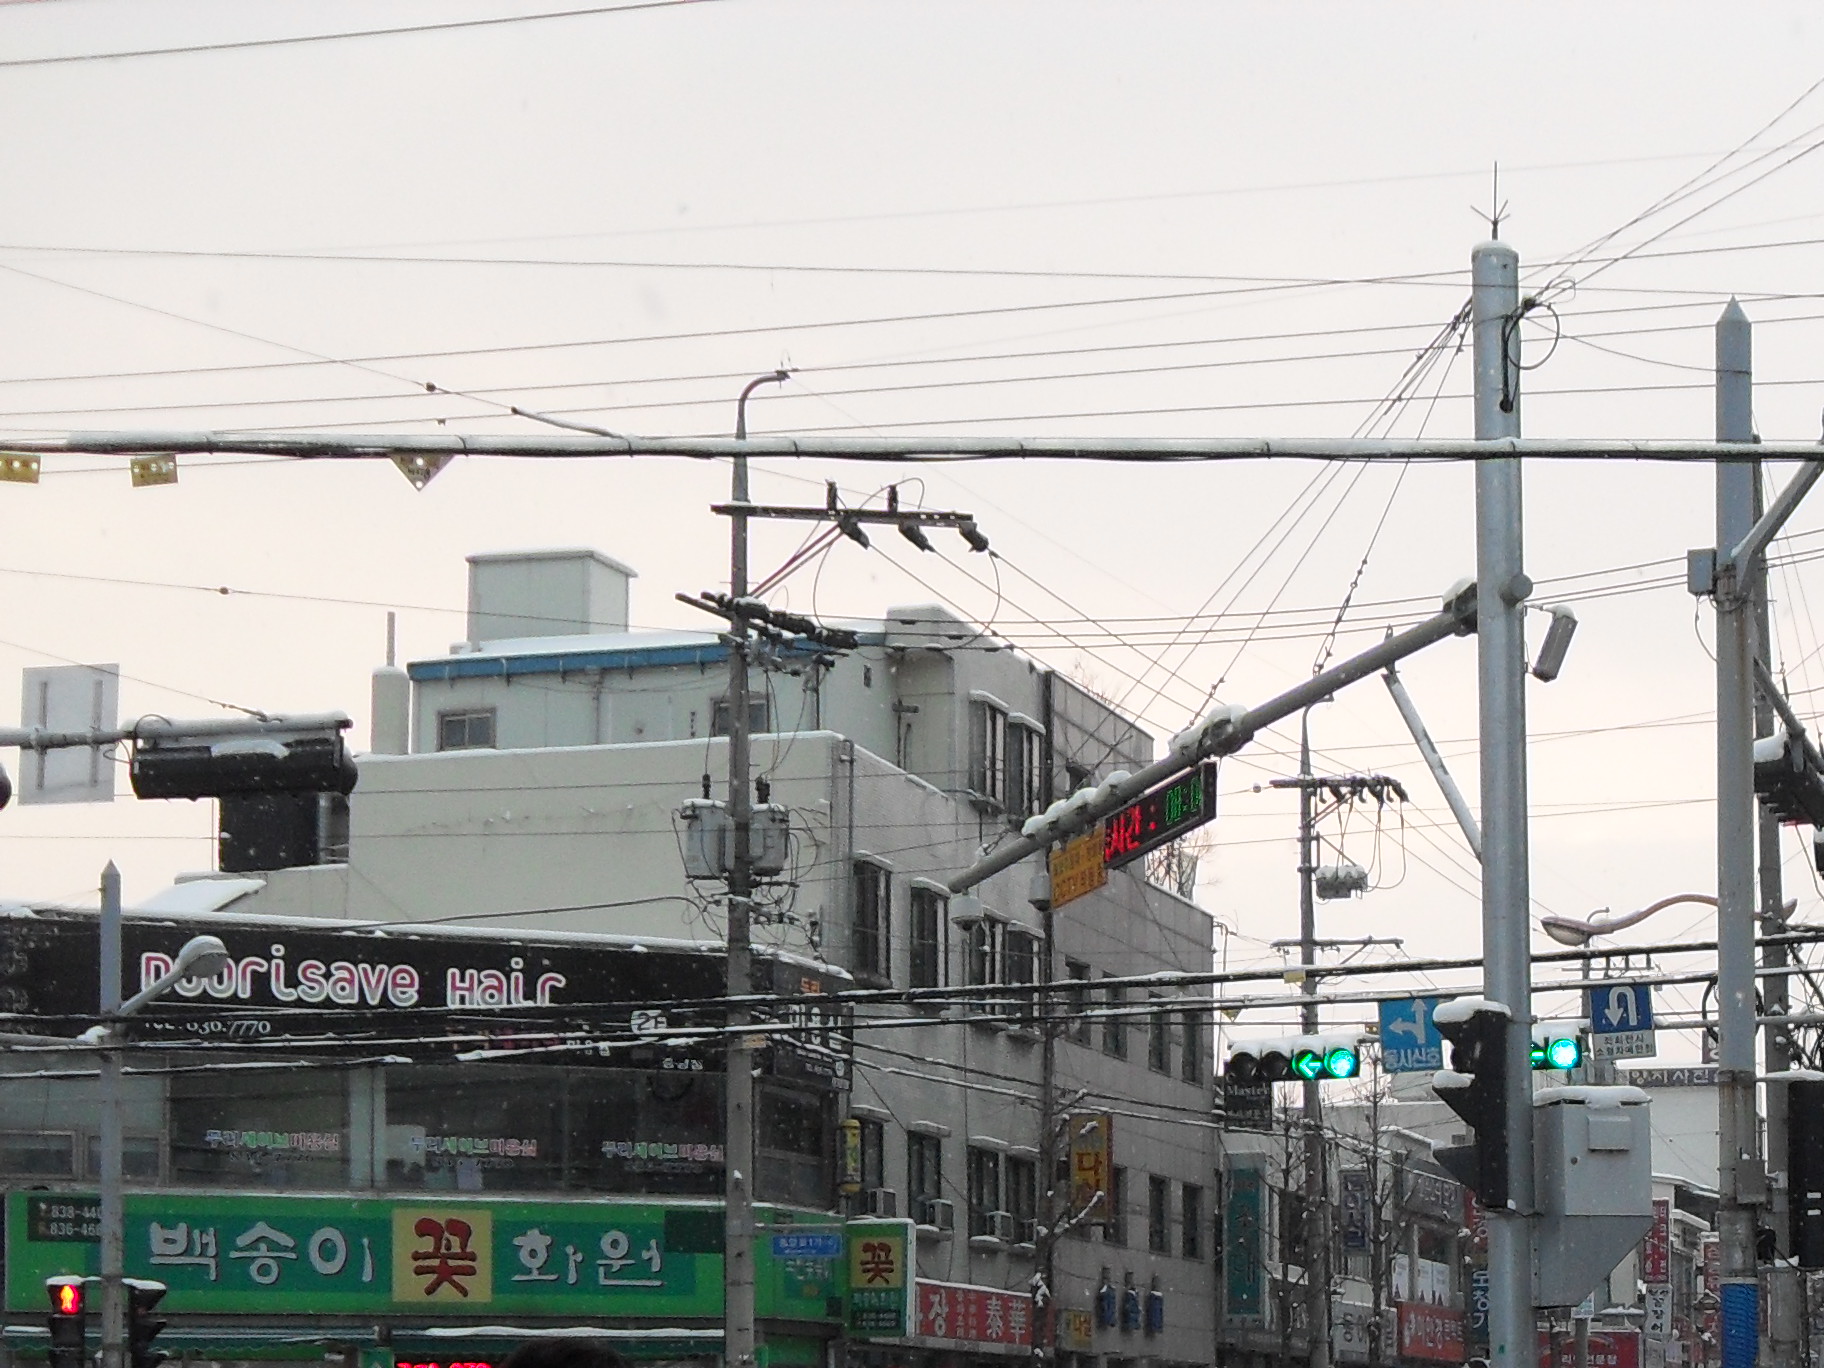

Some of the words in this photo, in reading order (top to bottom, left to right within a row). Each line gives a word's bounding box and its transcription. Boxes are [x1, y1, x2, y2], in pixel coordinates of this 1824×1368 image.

[446, 957, 567, 1008] Hair
[149, 1221, 374, 1285] 백송이
[410, 1217, 477, 1298] 꽃
[511, 1227, 665, 1287] 화원
[860, 1242, 894, 1284] 꽃
